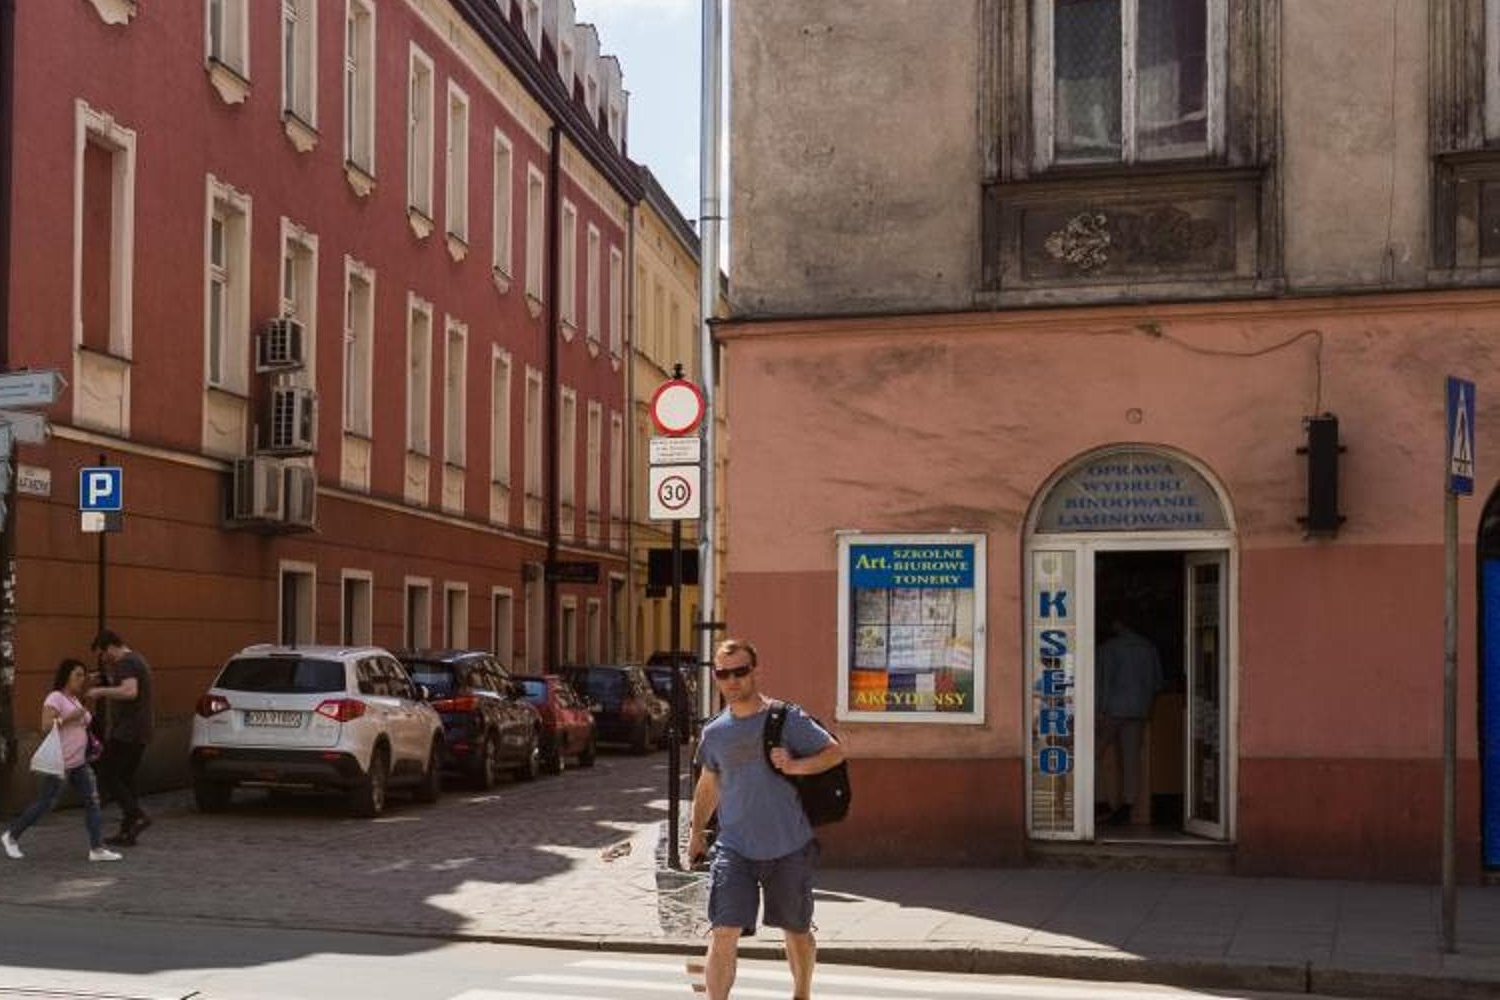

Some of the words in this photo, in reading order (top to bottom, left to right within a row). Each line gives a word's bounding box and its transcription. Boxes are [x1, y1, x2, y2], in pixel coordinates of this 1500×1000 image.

[89, 472, 114, 506] P
[663, 484, 687, 501] 30
[892, 549, 965, 560] SZKOLNE
[892, 561, 970, 572] BIUROWE
[893, 574, 962, 585] TONERY
[1038, 590, 1068, 777] KSERO
